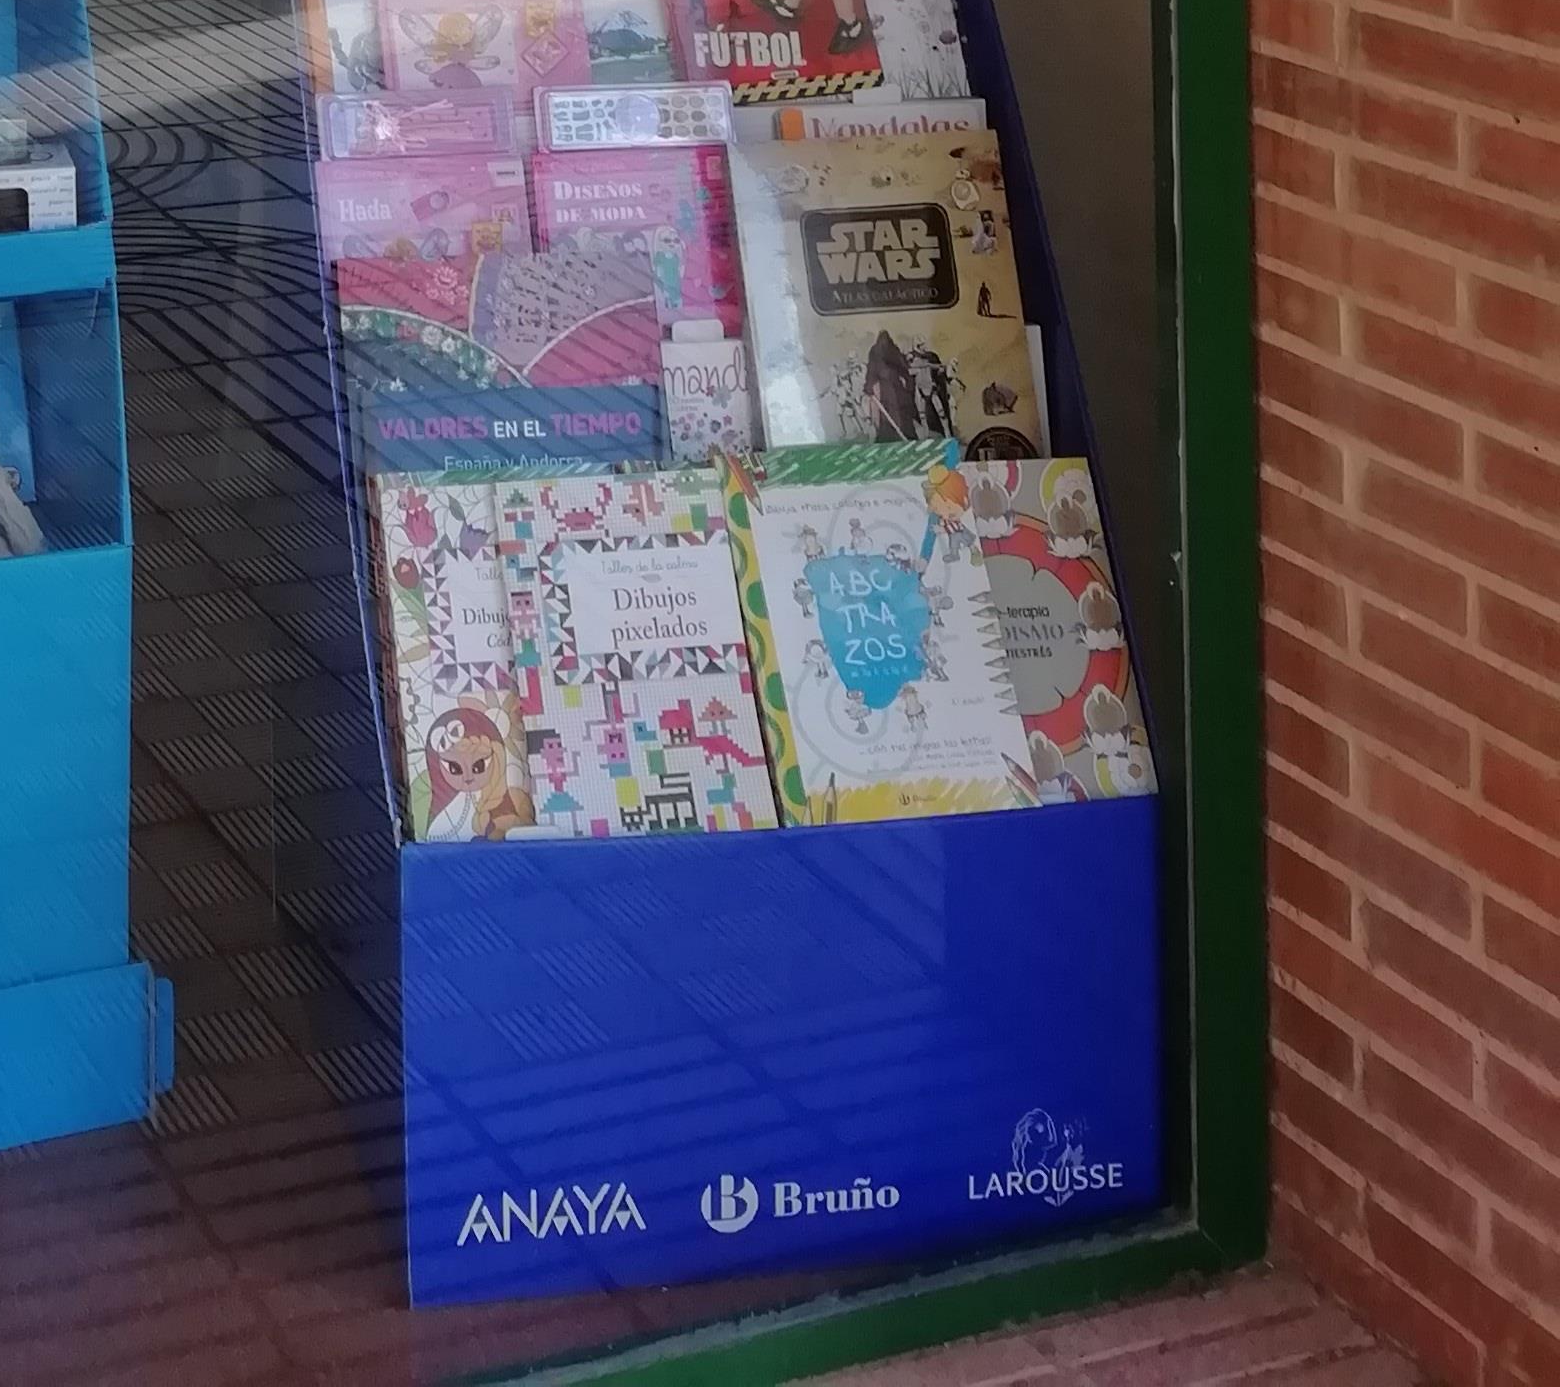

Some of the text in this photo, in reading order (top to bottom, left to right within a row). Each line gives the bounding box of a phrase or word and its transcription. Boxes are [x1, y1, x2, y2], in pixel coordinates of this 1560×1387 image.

[693, 23, 807, 69] FÚTBOL
[338, 198, 393, 224] Hada
[555, 207, 583, 224] DE
[815, 218, 939, 254] STAR
[817, 247, 941, 285] WARS
[378, 411, 642, 440] VALORES EN EL TIEMPO
[444, 454, 502, 471] España
[829, 568, 893, 597] ABC
[612, 587, 697, 615] Dibujos
[835, 600, 897, 634] TRA
[610, 614, 709, 650] pixelados
[844, 633, 907, 666] ZOS
[772, 1177, 900, 1219] Bruño
[967, 1162, 1124, 1202] LAROUSSE
[456, 1181, 646, 1246] ANAYA
